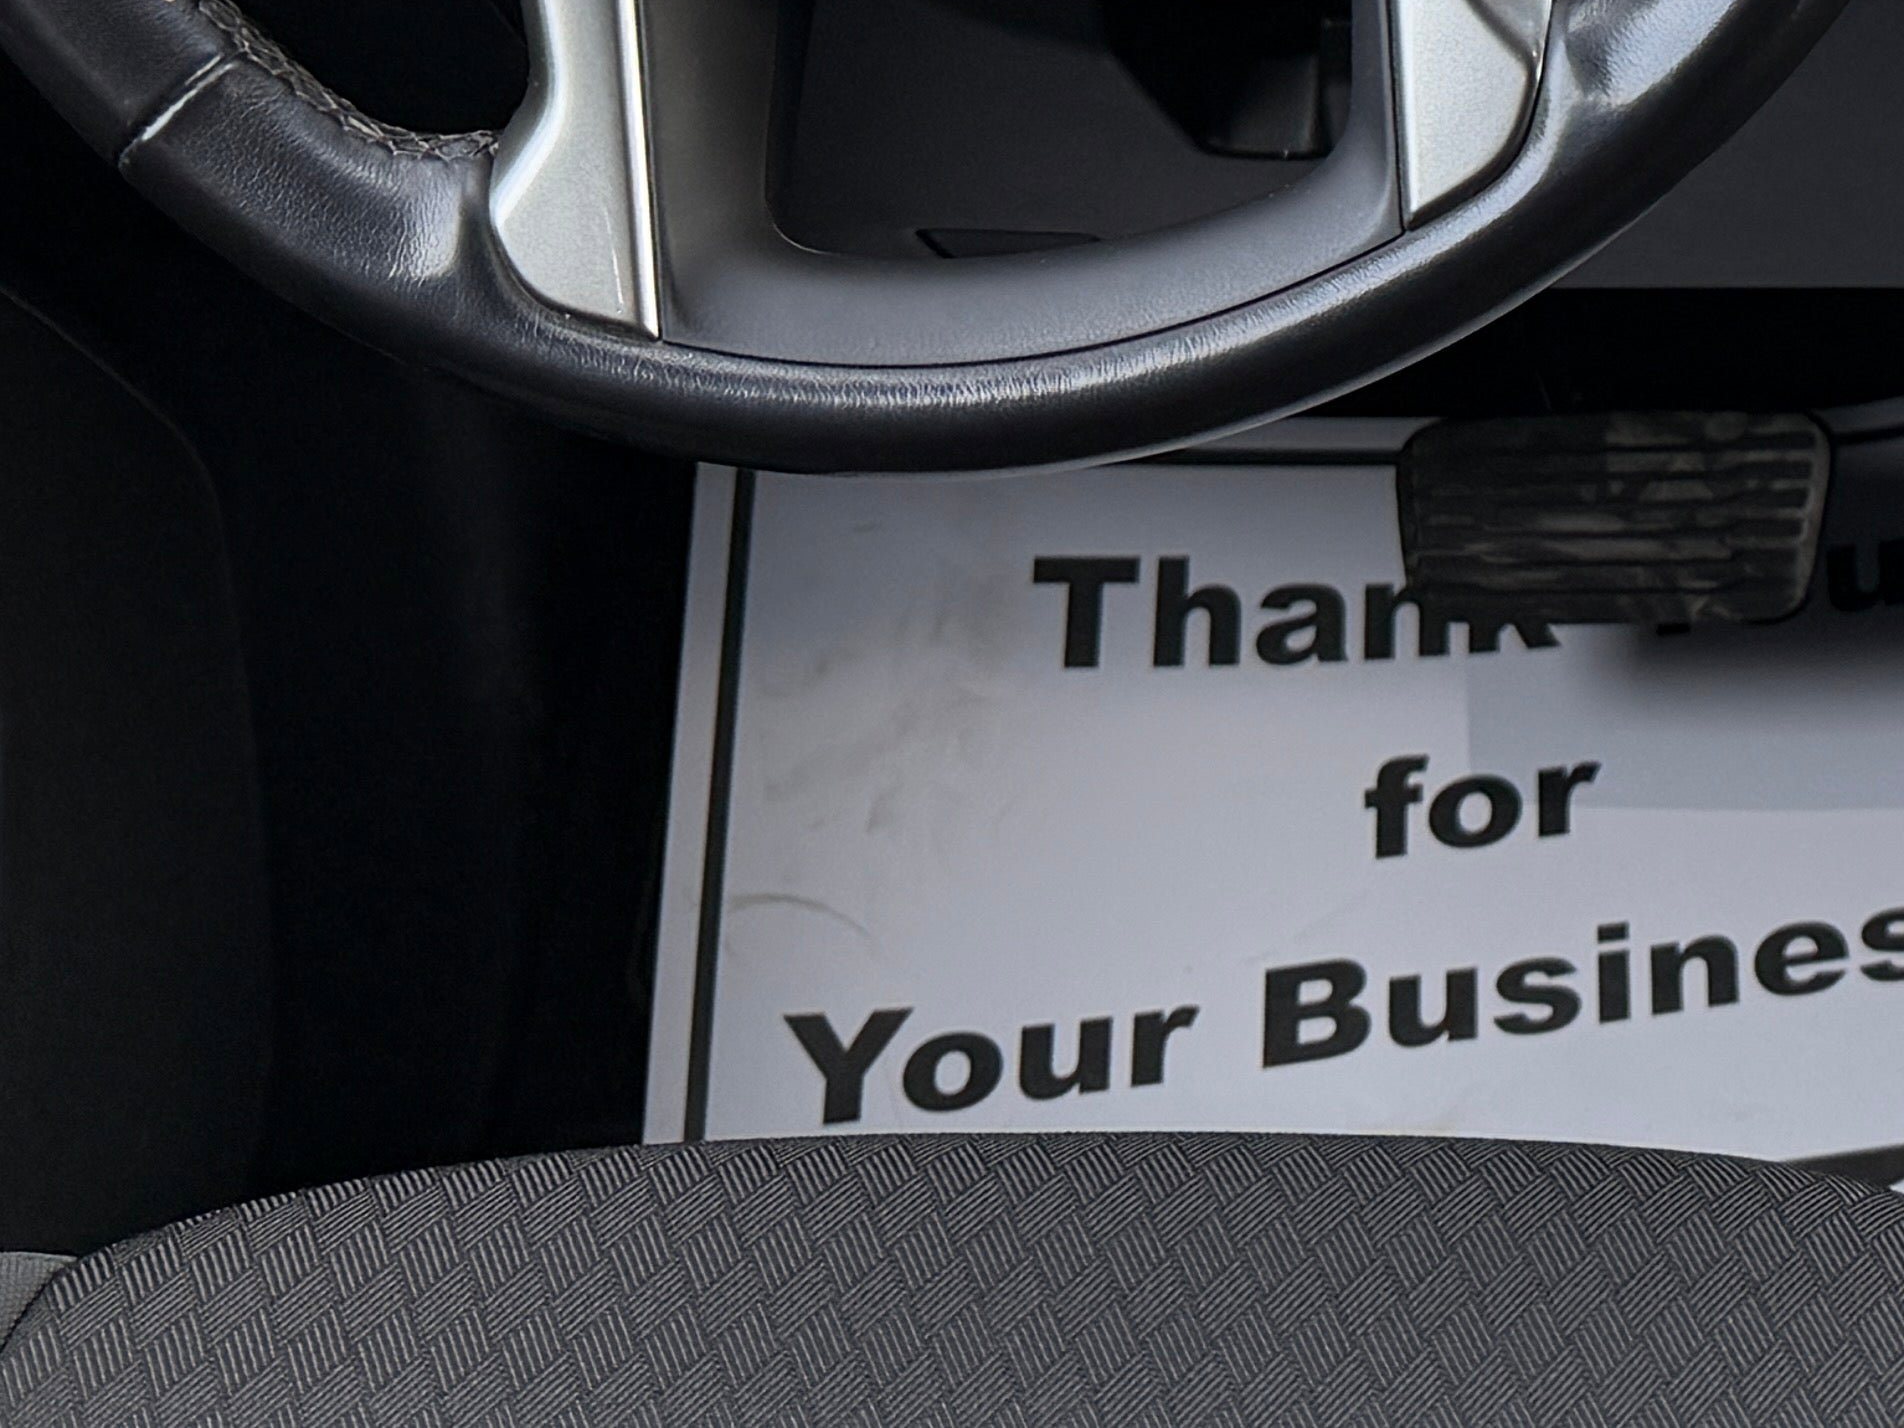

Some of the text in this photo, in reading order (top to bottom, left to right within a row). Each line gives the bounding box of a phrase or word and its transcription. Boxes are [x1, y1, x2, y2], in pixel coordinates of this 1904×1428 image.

[1032, 554, 1560, 669] Than
[1364, 755, 1602, 859] for
[784, 1003, 1200, 1126] Your
